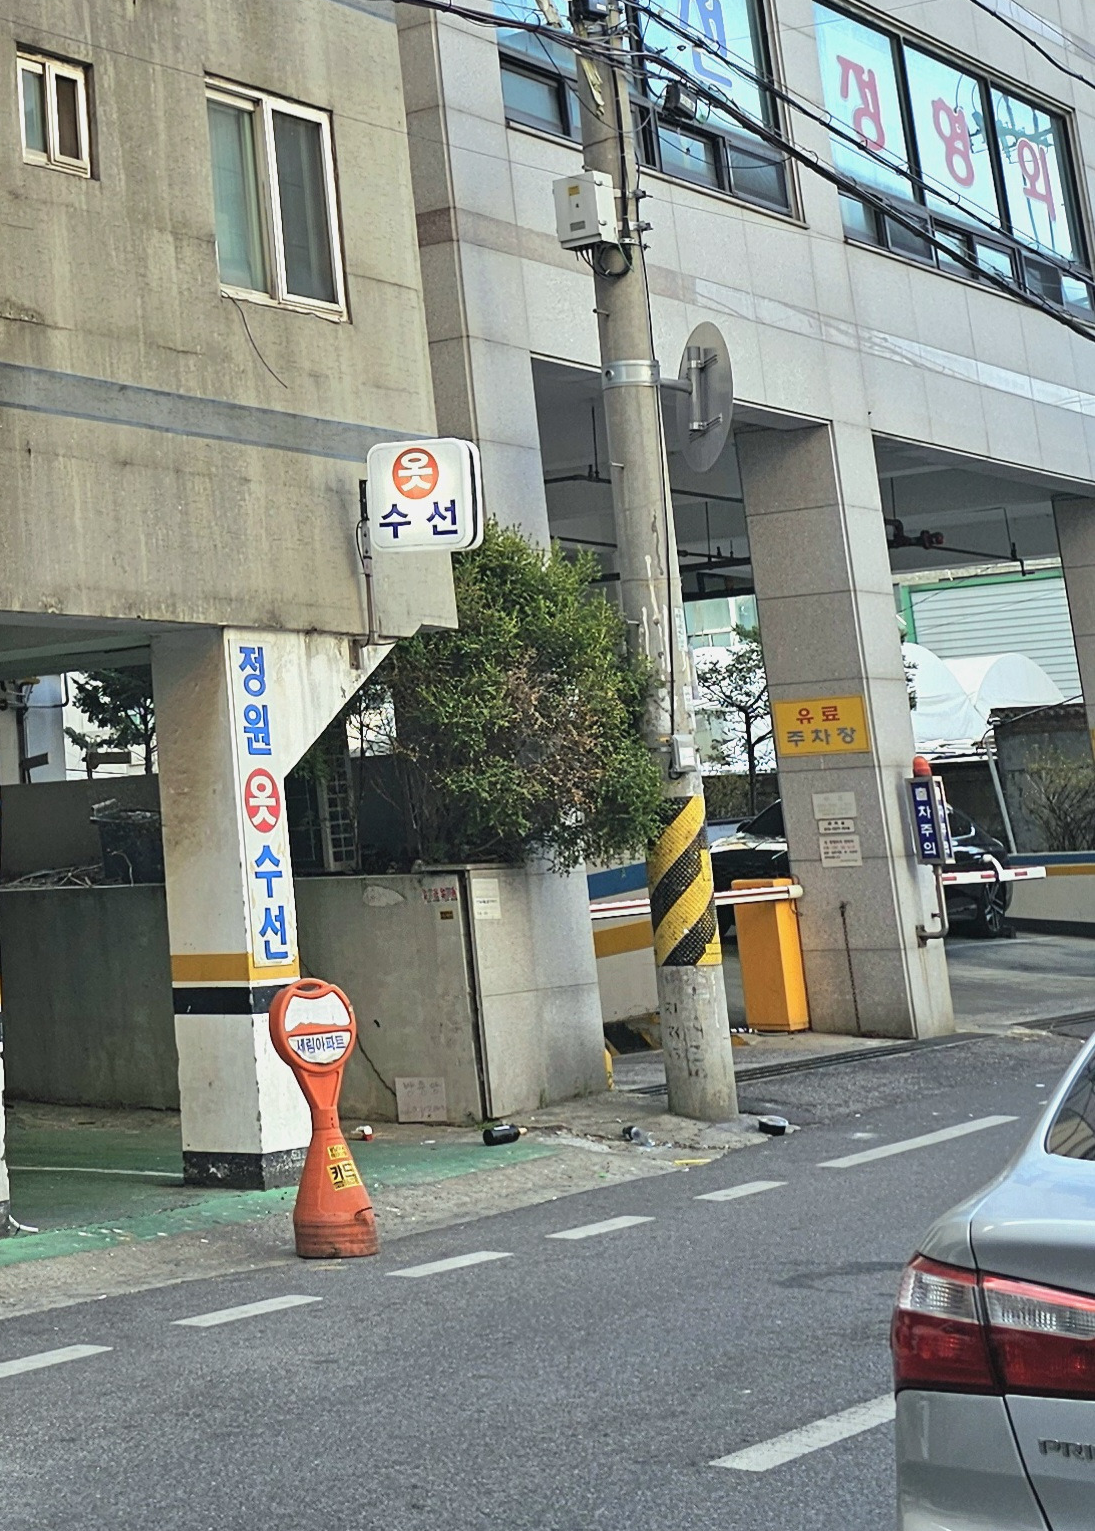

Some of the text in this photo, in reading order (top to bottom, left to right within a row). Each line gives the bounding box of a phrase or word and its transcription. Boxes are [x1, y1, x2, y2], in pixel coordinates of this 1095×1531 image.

[397, 452, 434, 492] 옷
[379, 499, 459, 539] 수선
[796, 705, 841, 724] 유료
[787, 727, 857, 747] 주차장
[239, 646, 290, 961] 정원 옷 수선
[915, 787, 937, 856] 차주의
[297, 1035, 347, 1054] 세림아파트
[329, 1163, 356, 1181] 카드
